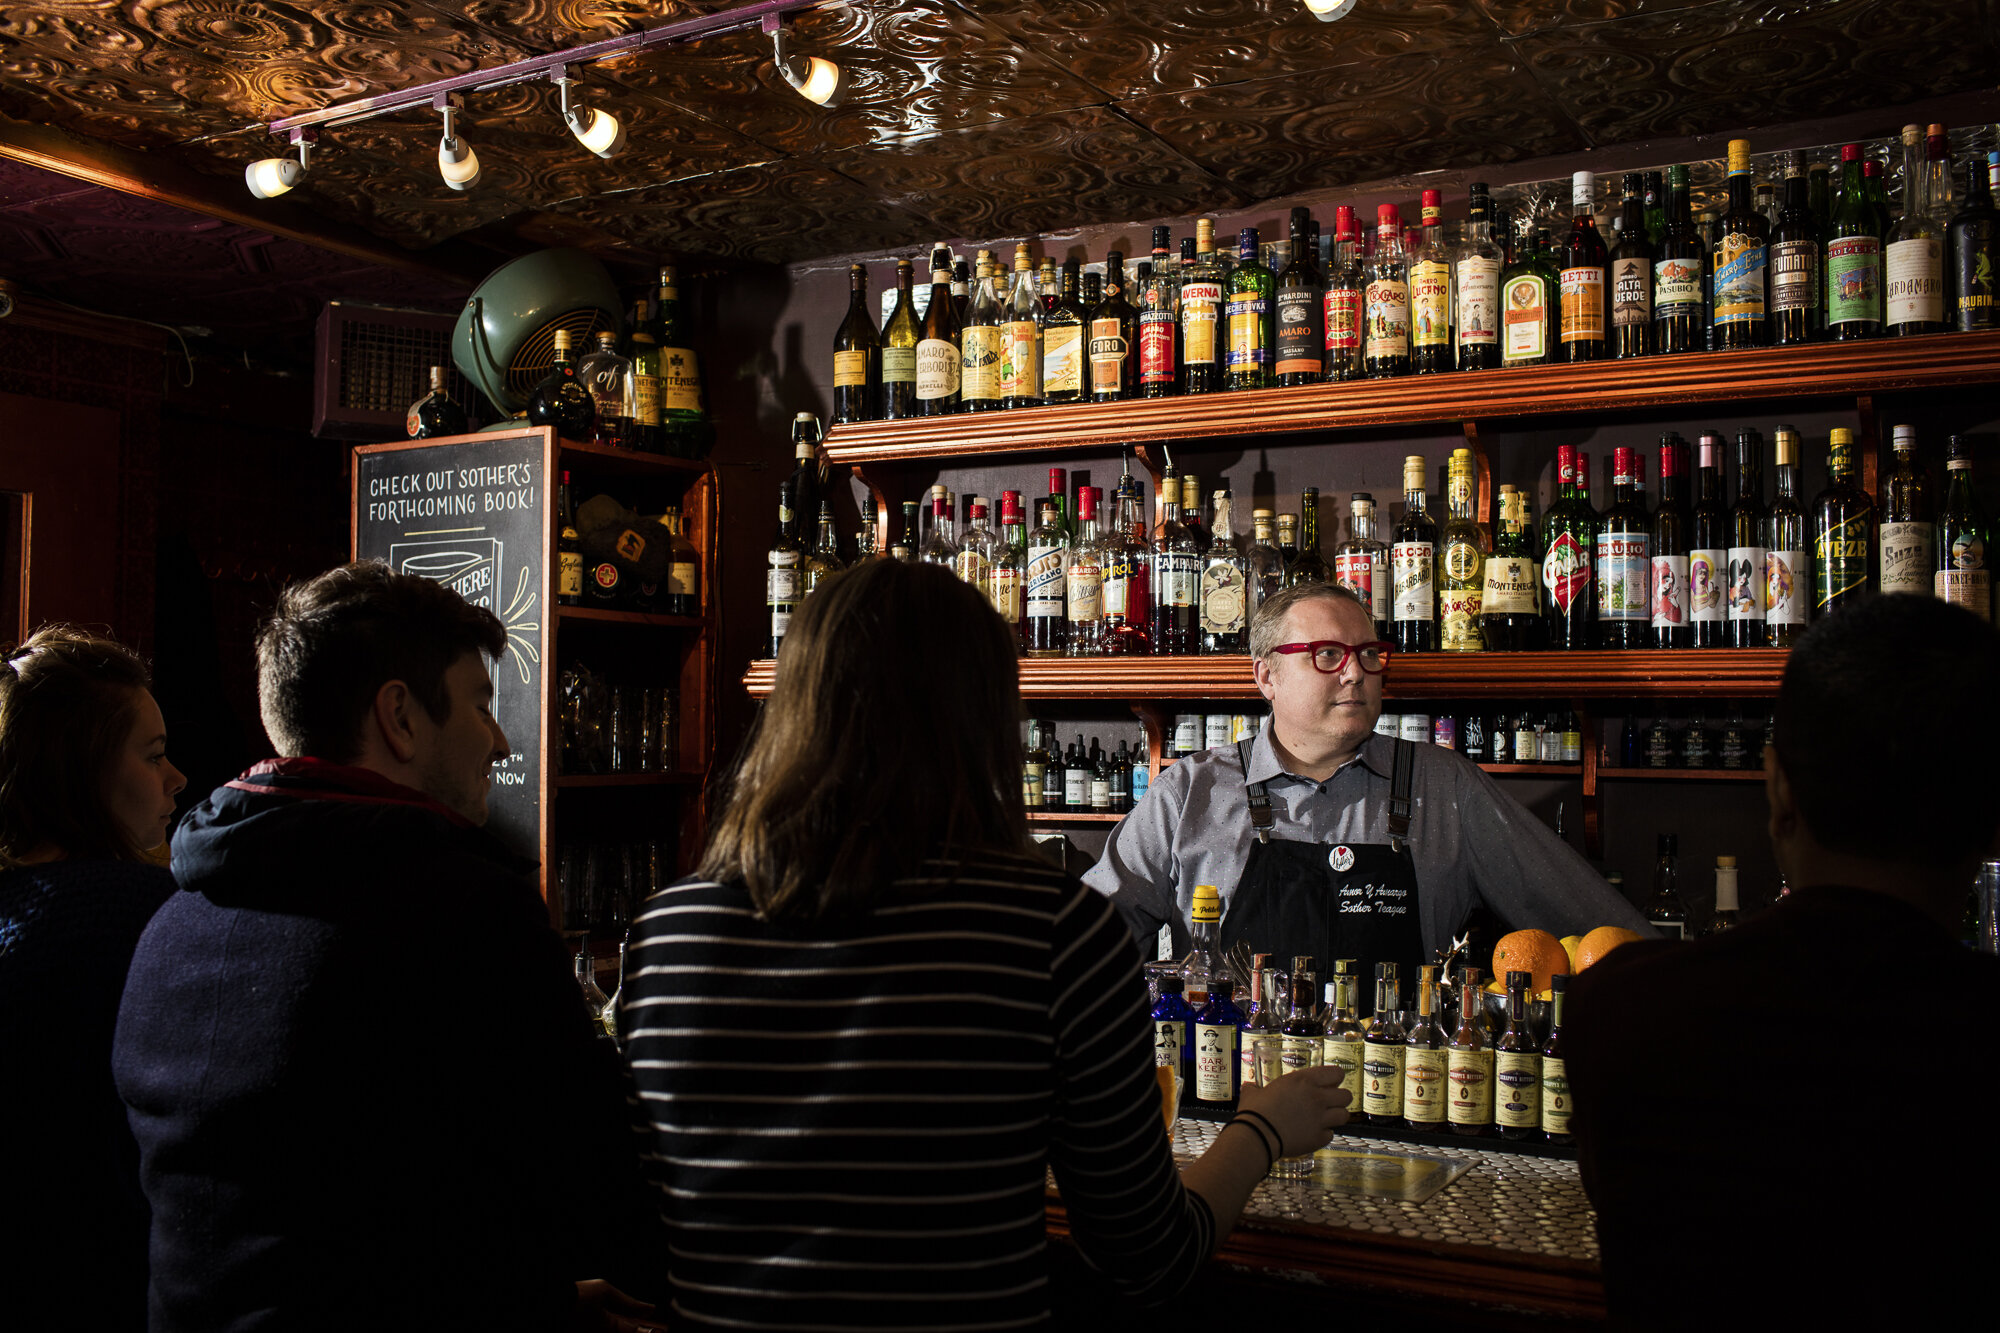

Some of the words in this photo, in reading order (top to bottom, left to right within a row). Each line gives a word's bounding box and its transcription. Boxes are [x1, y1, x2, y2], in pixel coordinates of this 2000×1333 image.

[1560, 271, 1598, 285] ELETTI
[1618, 280, 1640, 291] ALTA
[1660, 284, 1693, 295] PASUBIO
[1182, 287, 1219, 299] AVERNA
[1325, 291, 1357, 299] LUXARDO
[1412, 285, 1447, 299] LUCANO
[1615, 291, 1645, 303] VERDE
[1958, 294, 1993, 309] MAURIN
[1225, 302, 1266, 314] BECHEROVKA
[1279, 327, 1311, 338] AMARO
[1093, 340, 1118, 353] FORO
[370, 474, 421, 496] CHECK
[426, 470, 454, 492] OUT
[459, 463, 531, 489] SOTHER'S
[369, 493, 476, 524] FORTHCOMING
[484, 487, 534, 512] BOOK!
[1598, 545, 1643, 555] BRAULIO
[1885, 546, 1922, 570] Suze
[1336, 563, 1370, 572] AMARO
[1028, 568, 1061, 588] ERICANO
[993, 583, 1016, 599] Btter
[1488, 579, 1536, 591] MONTENEG
[495, 772, 525, 785] NOW
[1339, 884, 1363, 897] Amor
[1365, 884, 1374, 899] Y
[1375, 884, 1407, 900] Amargo
[1339, 900, 1372, 913] Sother
[1374, 901, 1407, 917] Teague
[1201, 1057, 1222, 1065] BAR
[1199, 1064, 1226, 1072] KEEP
